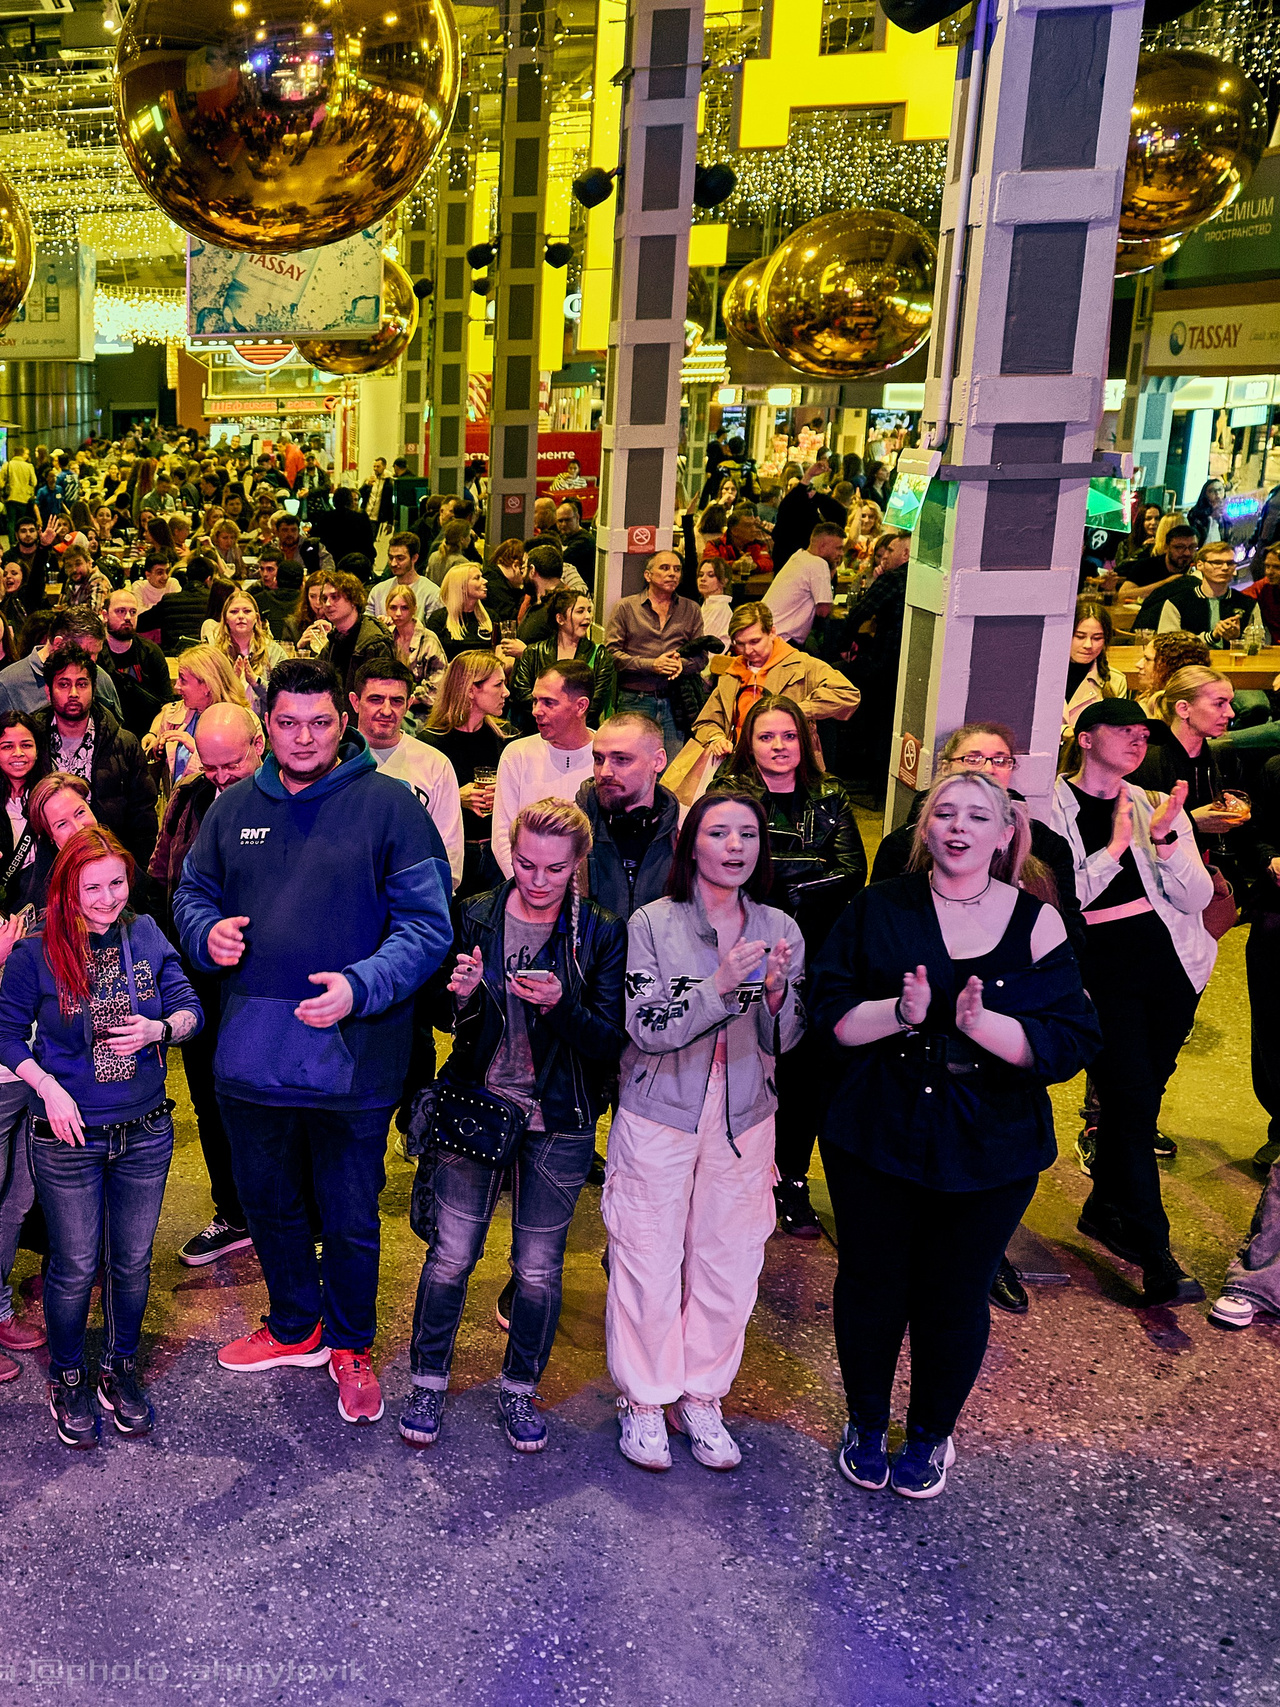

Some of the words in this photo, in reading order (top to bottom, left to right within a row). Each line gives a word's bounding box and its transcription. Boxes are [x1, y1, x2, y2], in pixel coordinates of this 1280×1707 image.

[1215, 196, 1275, 224] REMIUM
[1204, 222, 1273, 242] ПРОСТРАНСТВО
[1188, 323, 1243, 350] TASSAY
[464, 452, 490, 461] асть
[537, 450, 576, 460] менте
[240, 827, 271, 839] RNT
